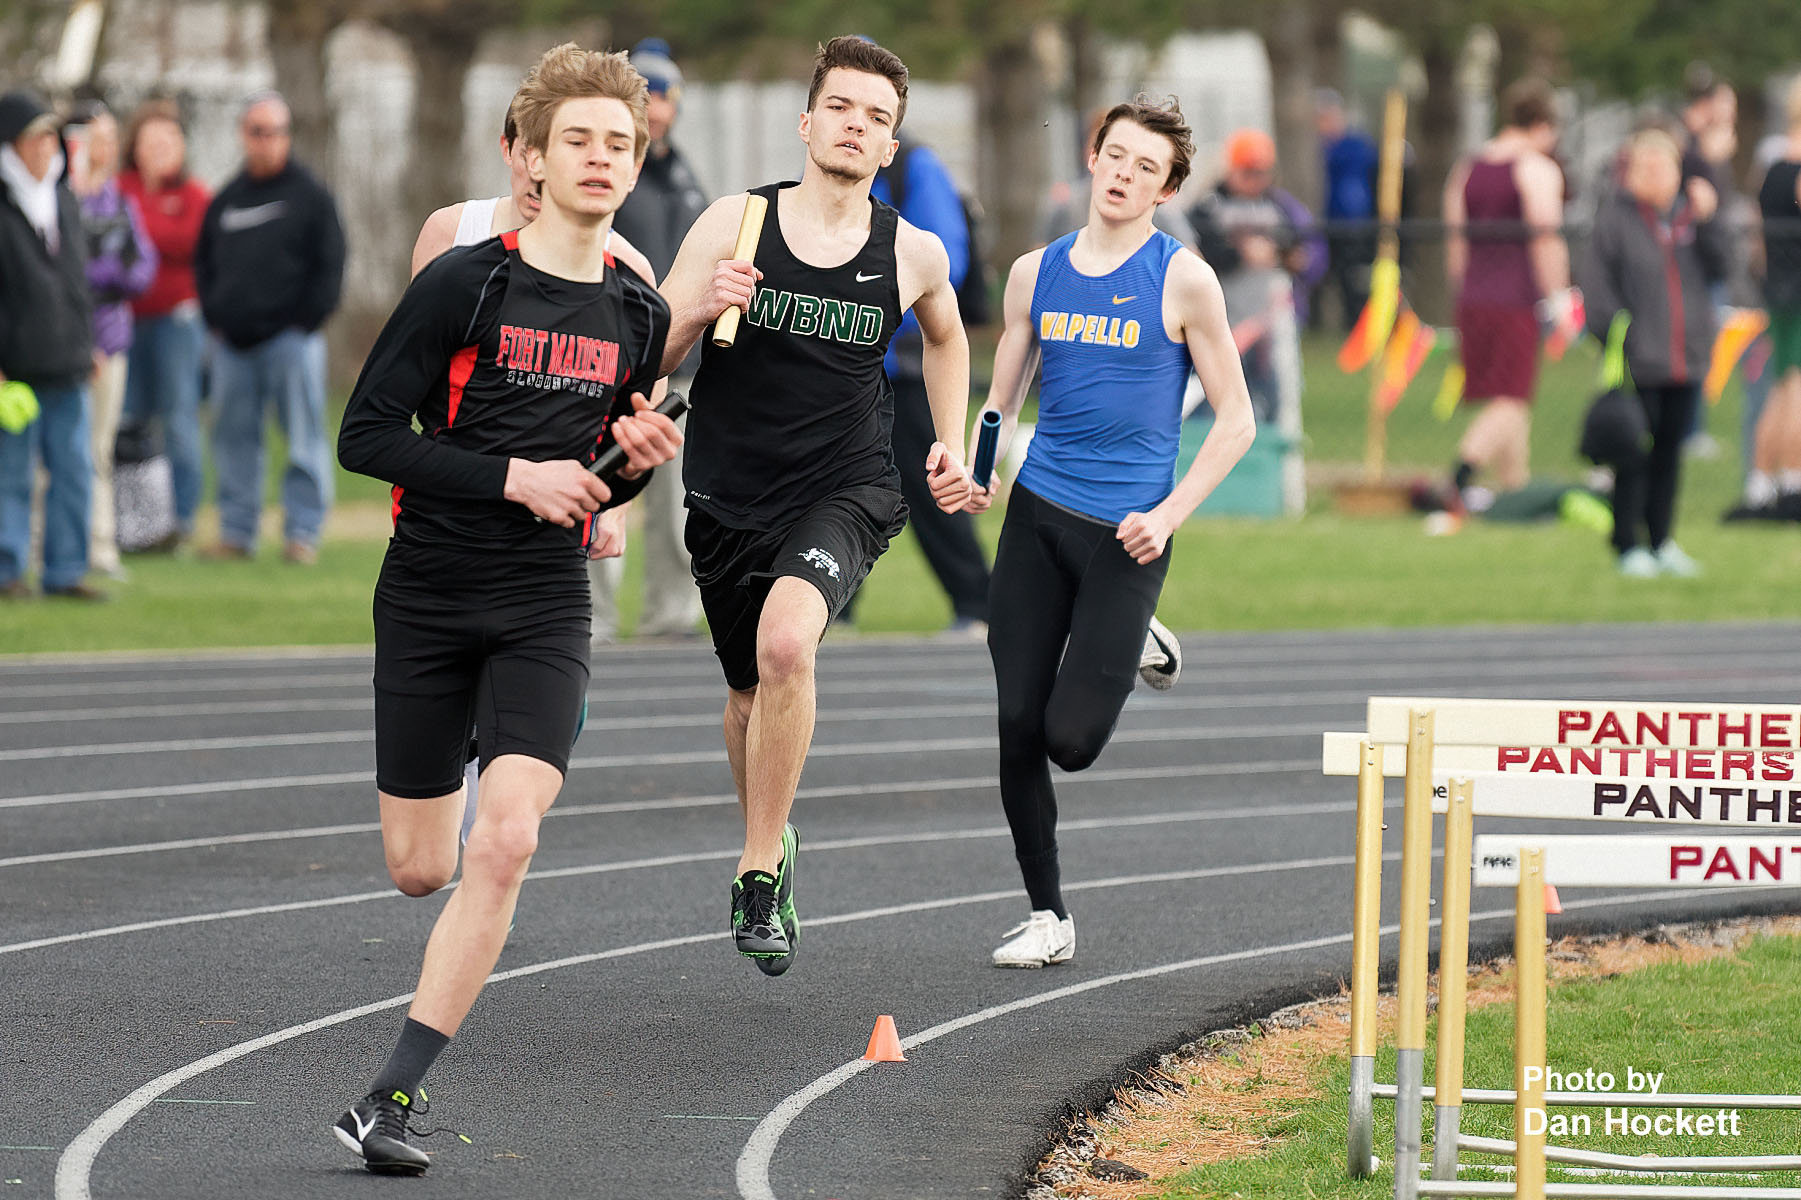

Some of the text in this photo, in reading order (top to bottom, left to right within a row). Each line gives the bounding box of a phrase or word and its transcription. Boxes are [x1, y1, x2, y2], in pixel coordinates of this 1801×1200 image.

[747, 286, 884, 345] WBND
[1041, 311, 1141, 349] WAPELLO
[496, 324, 620, 387] FORT MADISON
[1558, 710, 1801, 748] PANTHE
[1497, 746, 1795, 782] PANTHERS
